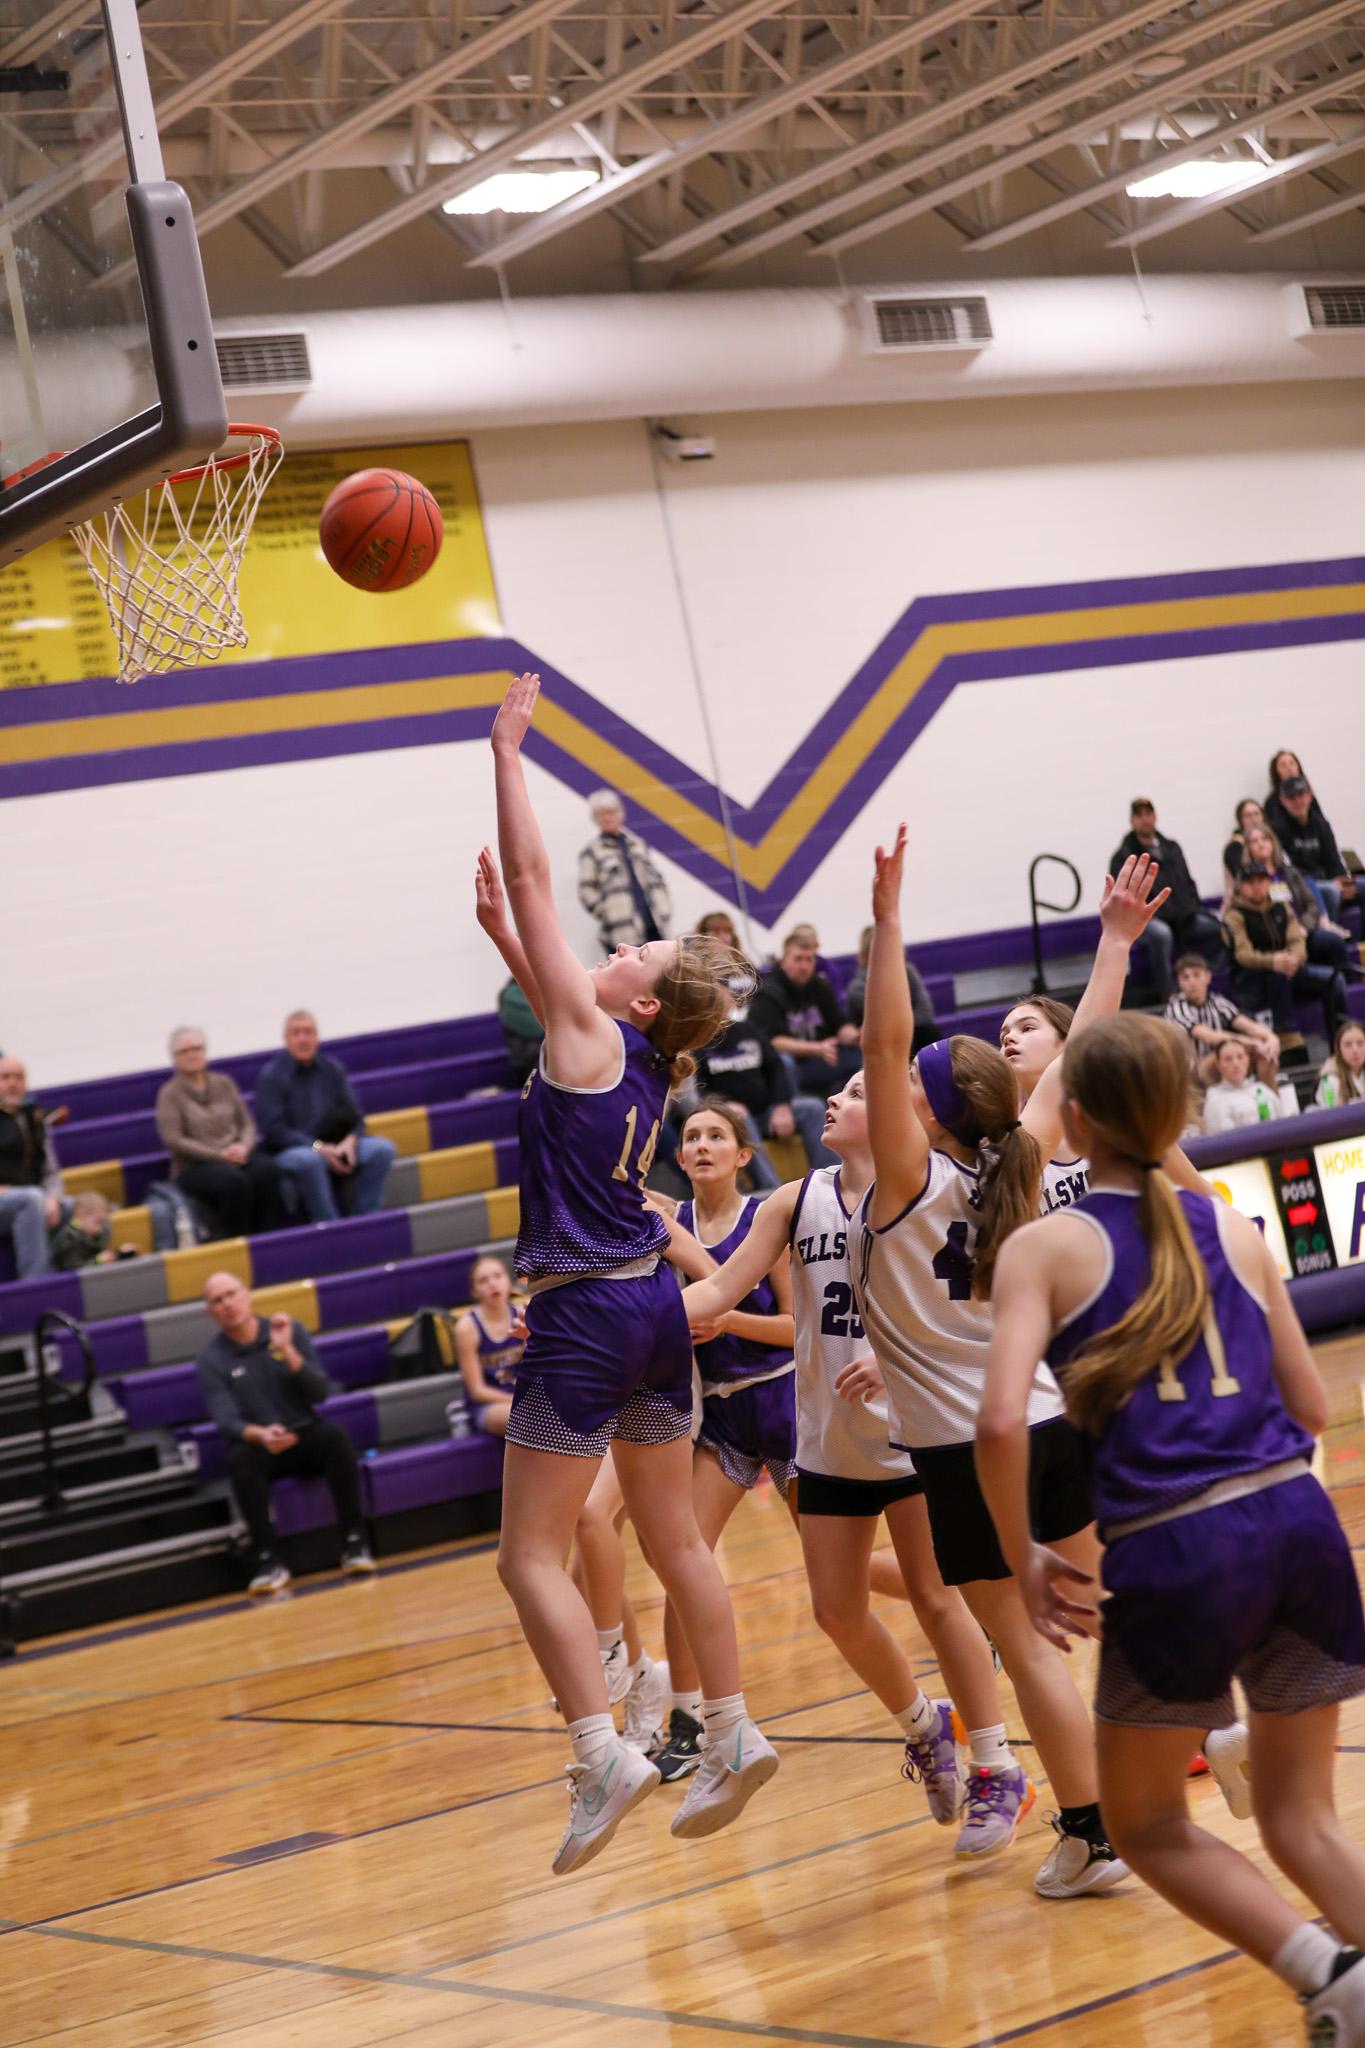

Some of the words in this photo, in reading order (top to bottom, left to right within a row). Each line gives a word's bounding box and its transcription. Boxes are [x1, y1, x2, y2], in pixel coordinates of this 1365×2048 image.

[611, 1105, 660, 1190] 14
[797, 1232, 850, 1265] ELLS
[932, 1221, 986, 1300] 4
